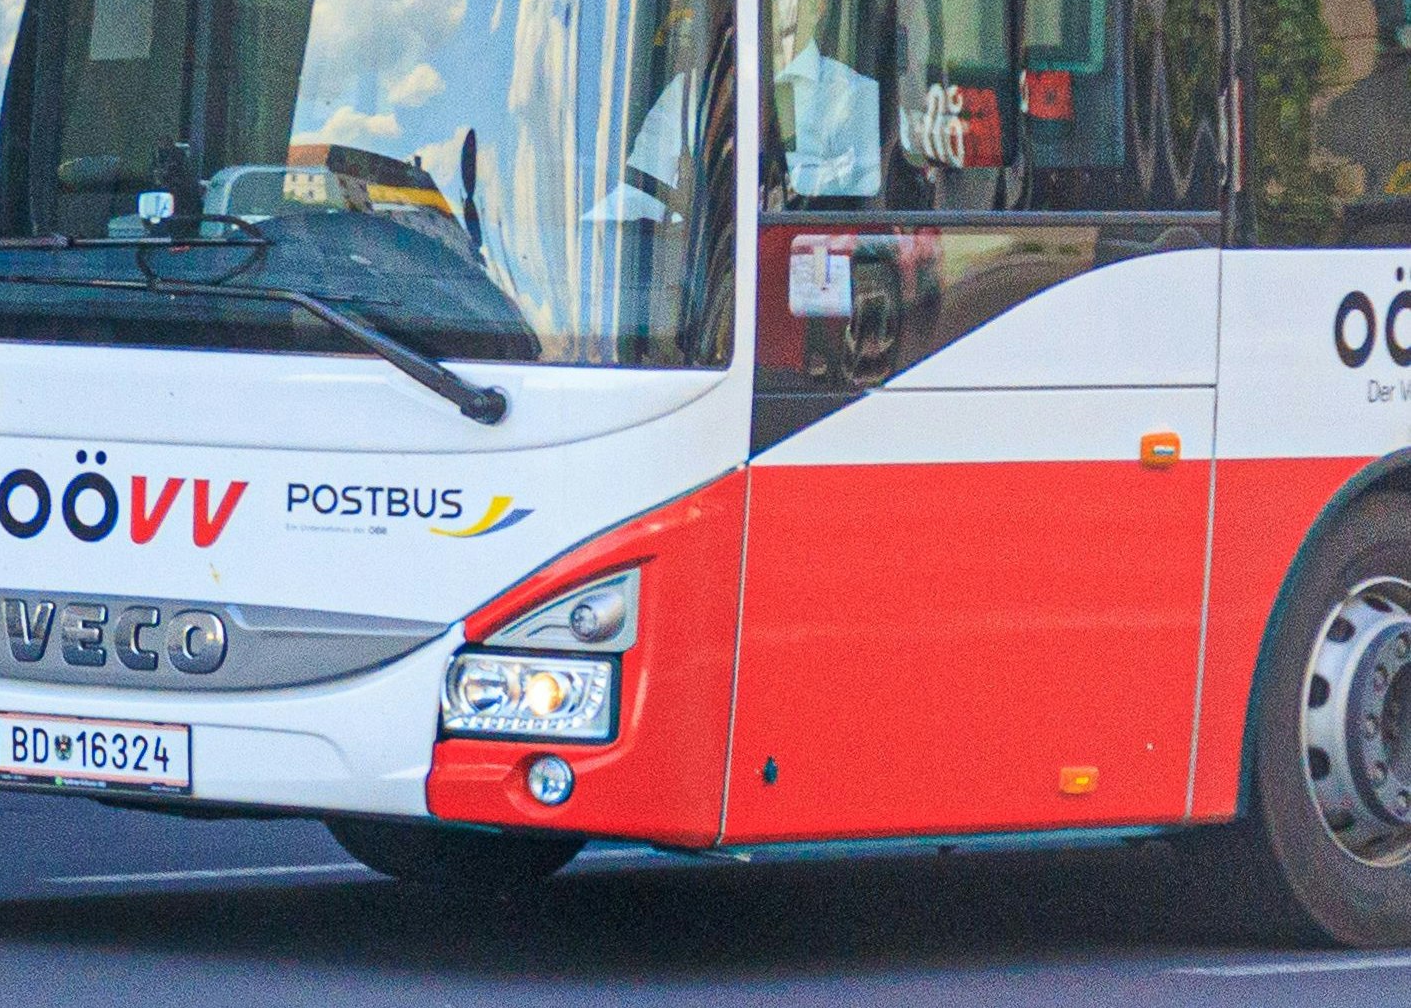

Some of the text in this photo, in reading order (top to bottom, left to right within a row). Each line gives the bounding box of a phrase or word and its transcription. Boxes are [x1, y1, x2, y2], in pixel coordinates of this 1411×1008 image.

[287, 482, 463, 519] POSTBUS
[11, 725, 50, 764] BD
[76, 730, 170, 773] 16324
